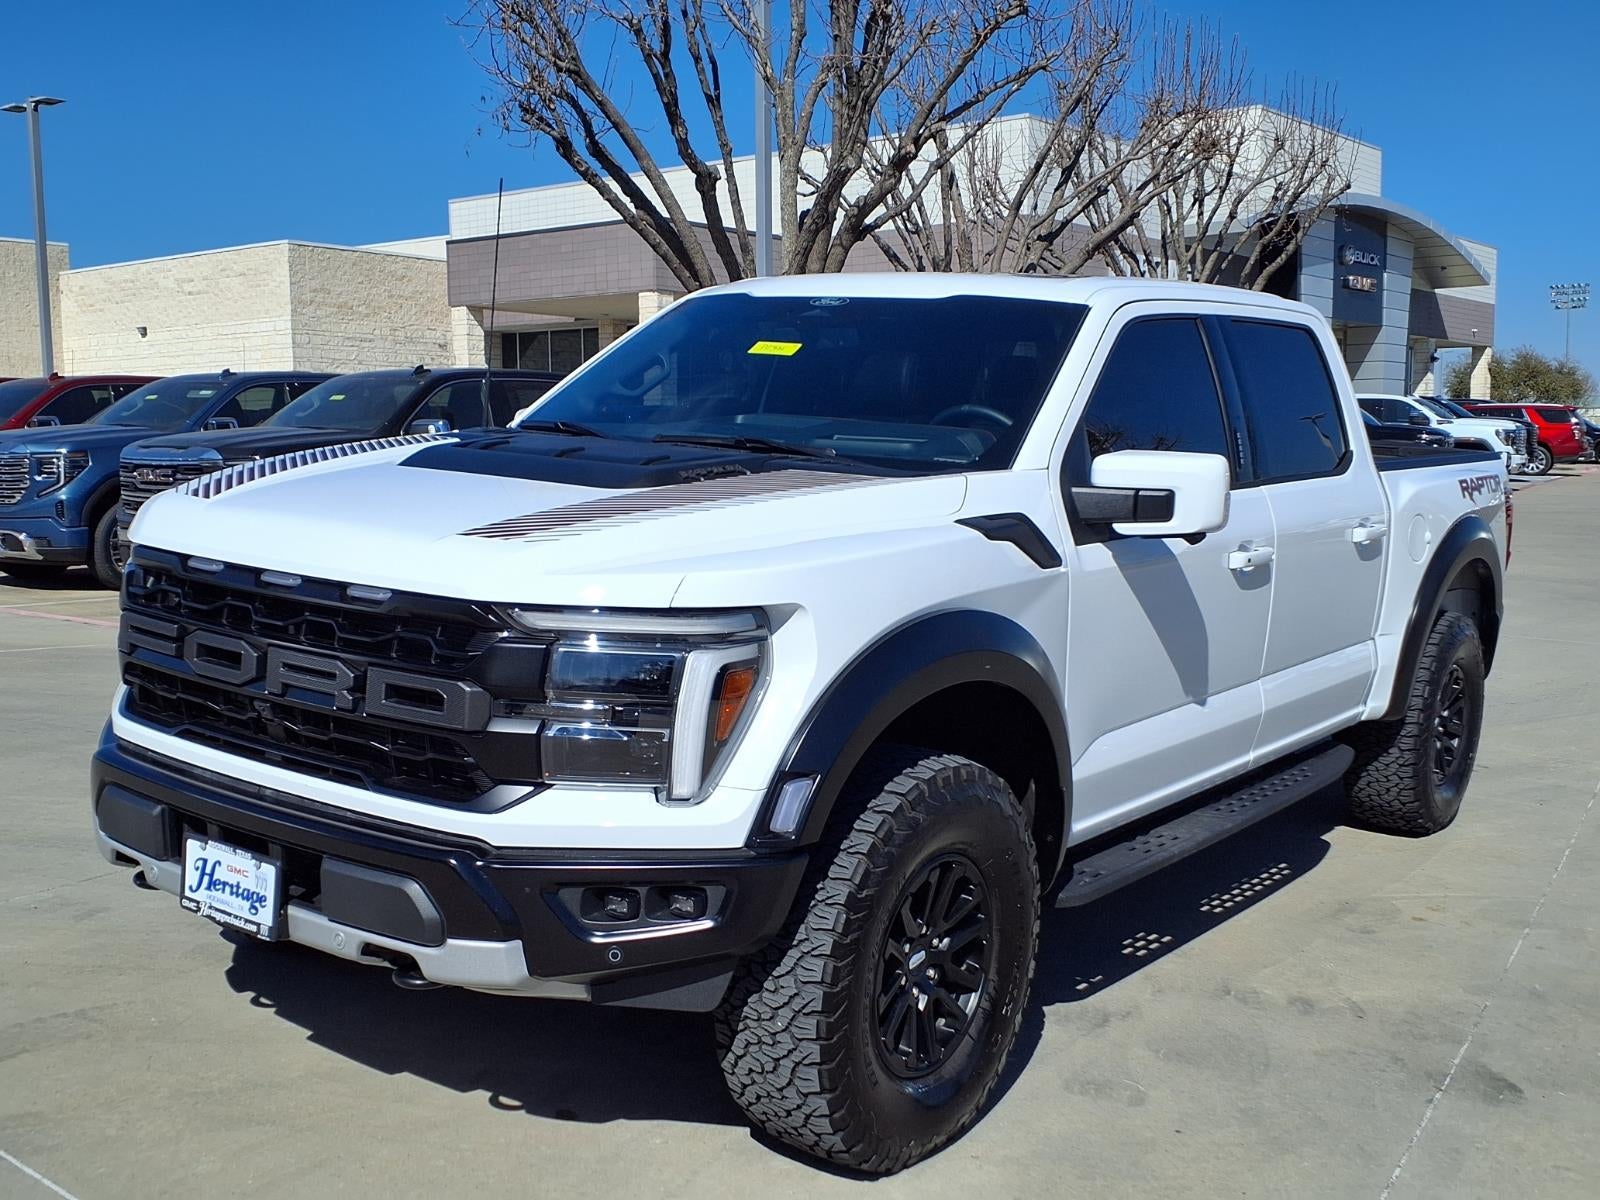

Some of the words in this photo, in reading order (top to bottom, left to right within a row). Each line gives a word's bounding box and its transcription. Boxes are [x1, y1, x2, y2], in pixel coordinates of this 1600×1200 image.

[1354, 250, 1380, 266] BUICK
[1457, 474, 1503, 505] RAPTOR
[119, 611, 491, 731] FORD
[189, 858, 266, 915] Heritage
[227, 865, 249, 877] GMC
